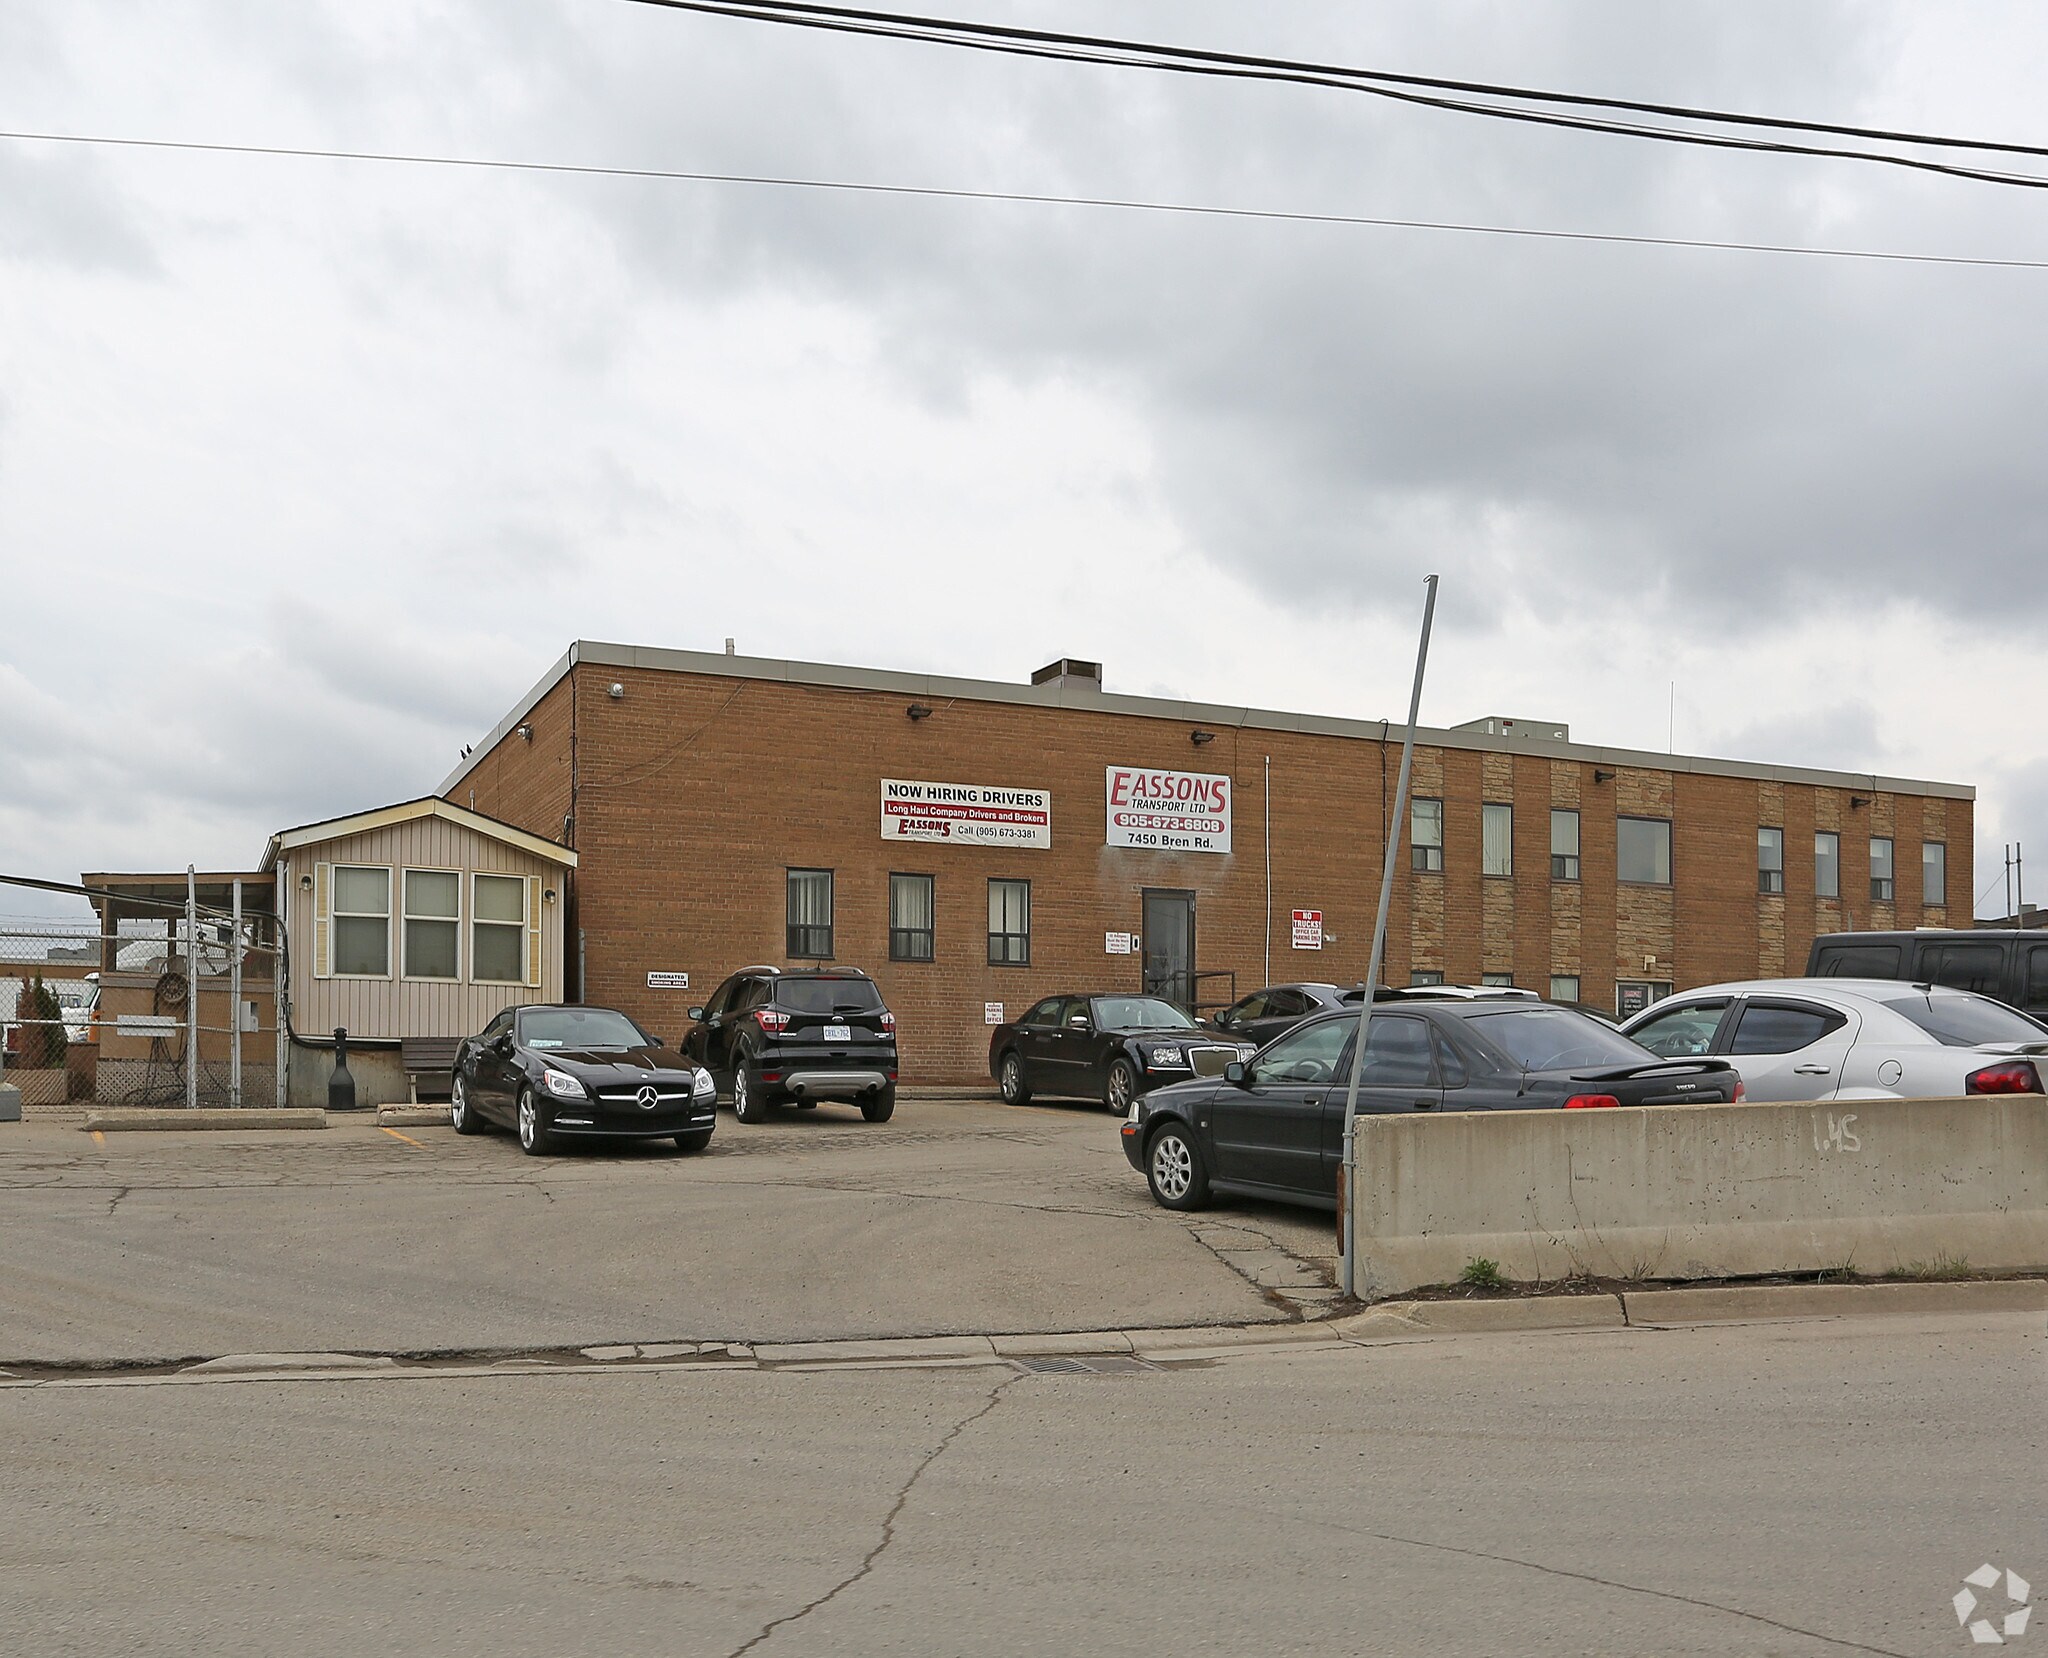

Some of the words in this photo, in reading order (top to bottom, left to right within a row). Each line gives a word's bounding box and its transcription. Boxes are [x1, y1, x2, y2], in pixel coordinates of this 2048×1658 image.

[888, 784, 922, 798] NOW
[927, 787, 978, 801] HIRING
[982, 791, 1043, 807] DRIVERS
[1110, 772, 1226, 813] EASSONS
[888, 803, 909, 815] Long
[910, 805, 929, 815] Haul
[930, 806, 967, 819] Company
[969, 809, 997, 820] Drivers
[998, 812, 1013, 821] and
[1014, 813, 1045, 823] Brokers
[1131, 798, 1185, 812] TRANSPORT
[1189, 803, 1205, 814] LTD
[898, 819, 951, 837] EASSONS
[957, 825, 974, 835] Call
[976, 826, 998, 838] (905)
[999, 828, 1036, 839] 673-3381
[1127, 833, 1157, 845] 7450
[1162, 835, 1189, 847] Bren
[1194, 837, 1213, 848] Rd.
[1302, 912, 1312, 920] NO
[1293, 920, 1321, 929] TRUCKS!
